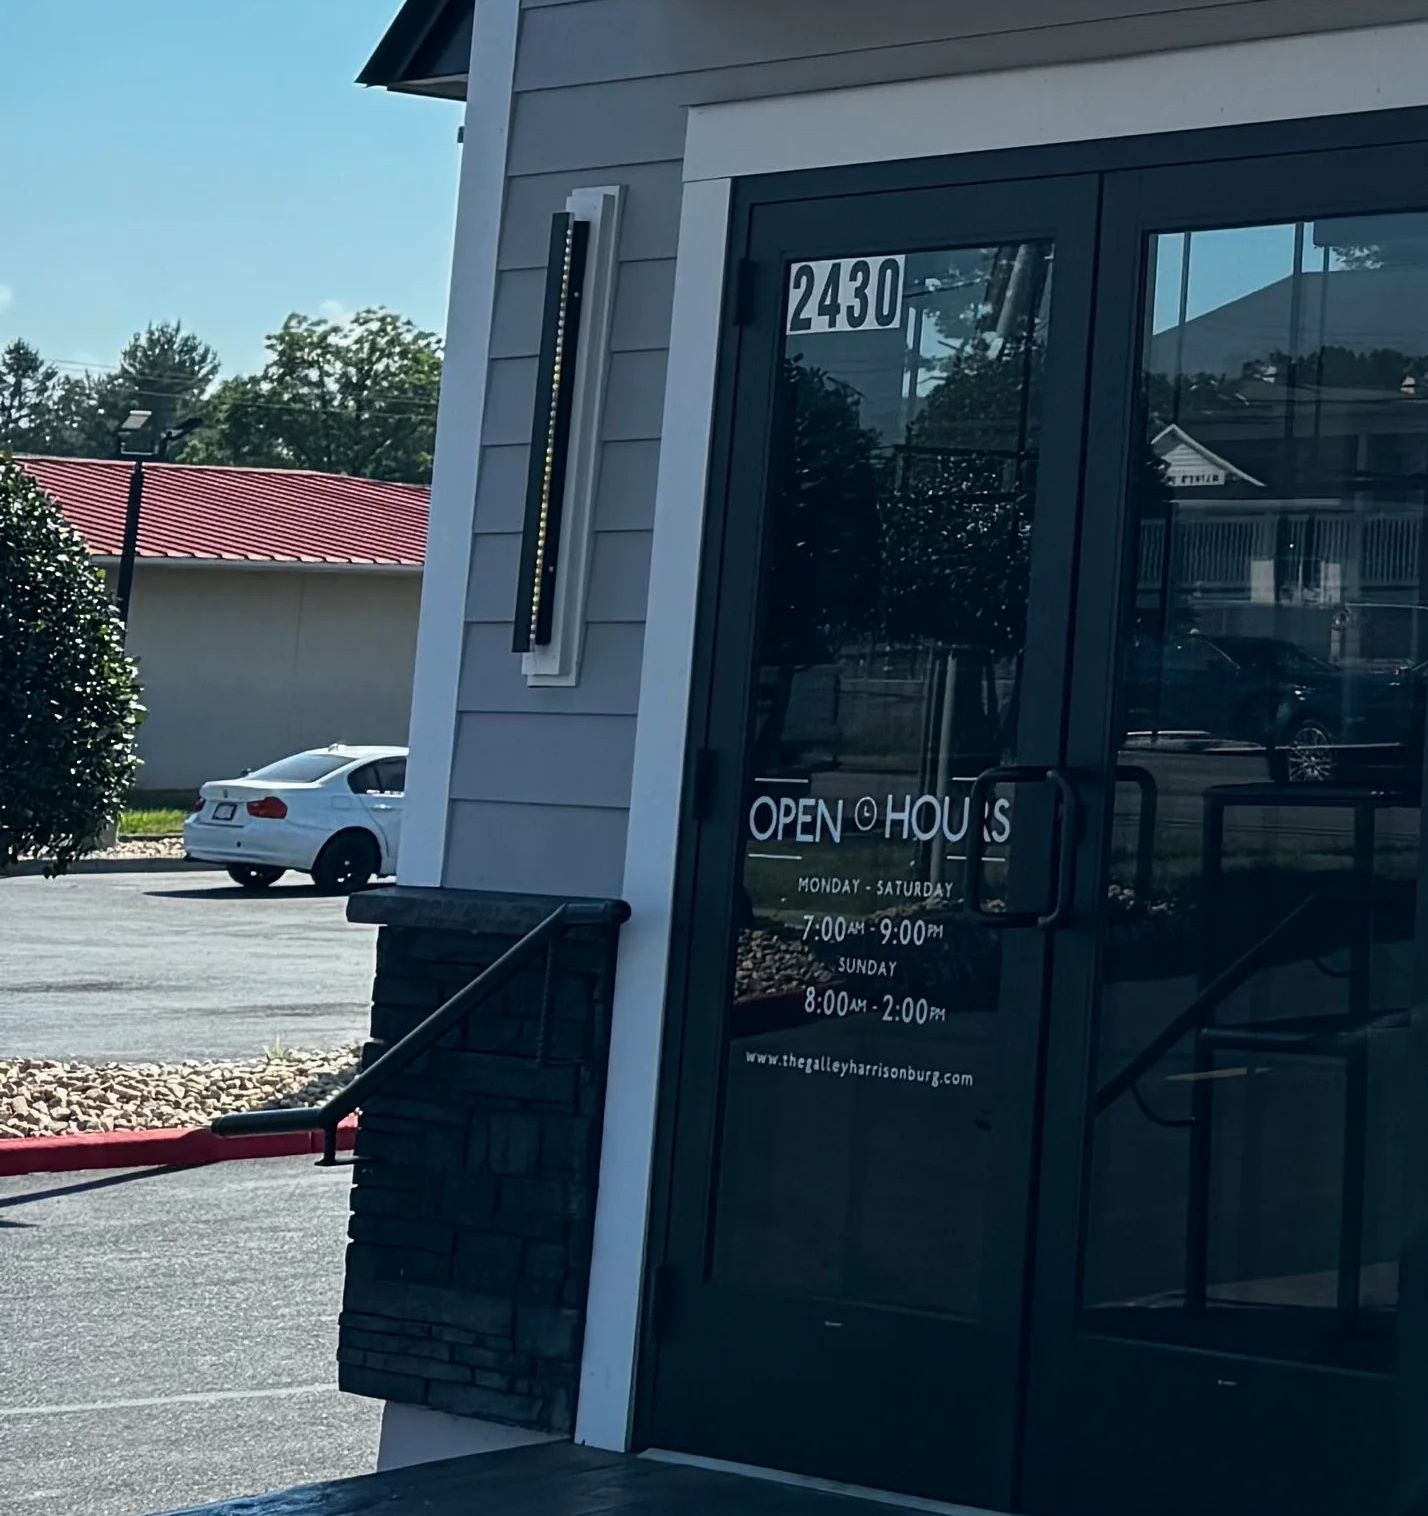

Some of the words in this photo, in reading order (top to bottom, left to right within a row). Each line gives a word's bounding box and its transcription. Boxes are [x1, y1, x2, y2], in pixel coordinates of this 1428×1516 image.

[789, 258, 901, 331] 2430
[748, 795, 844, 844] OPEN
[797, 876, 861, 894] MONDAY
[875, 879, 954, 898] SATURDAY
[837, 956, 898, 977] SUNDAY
[745, 1050, 974, 1088] www.thegalleyharrisonburg.com
